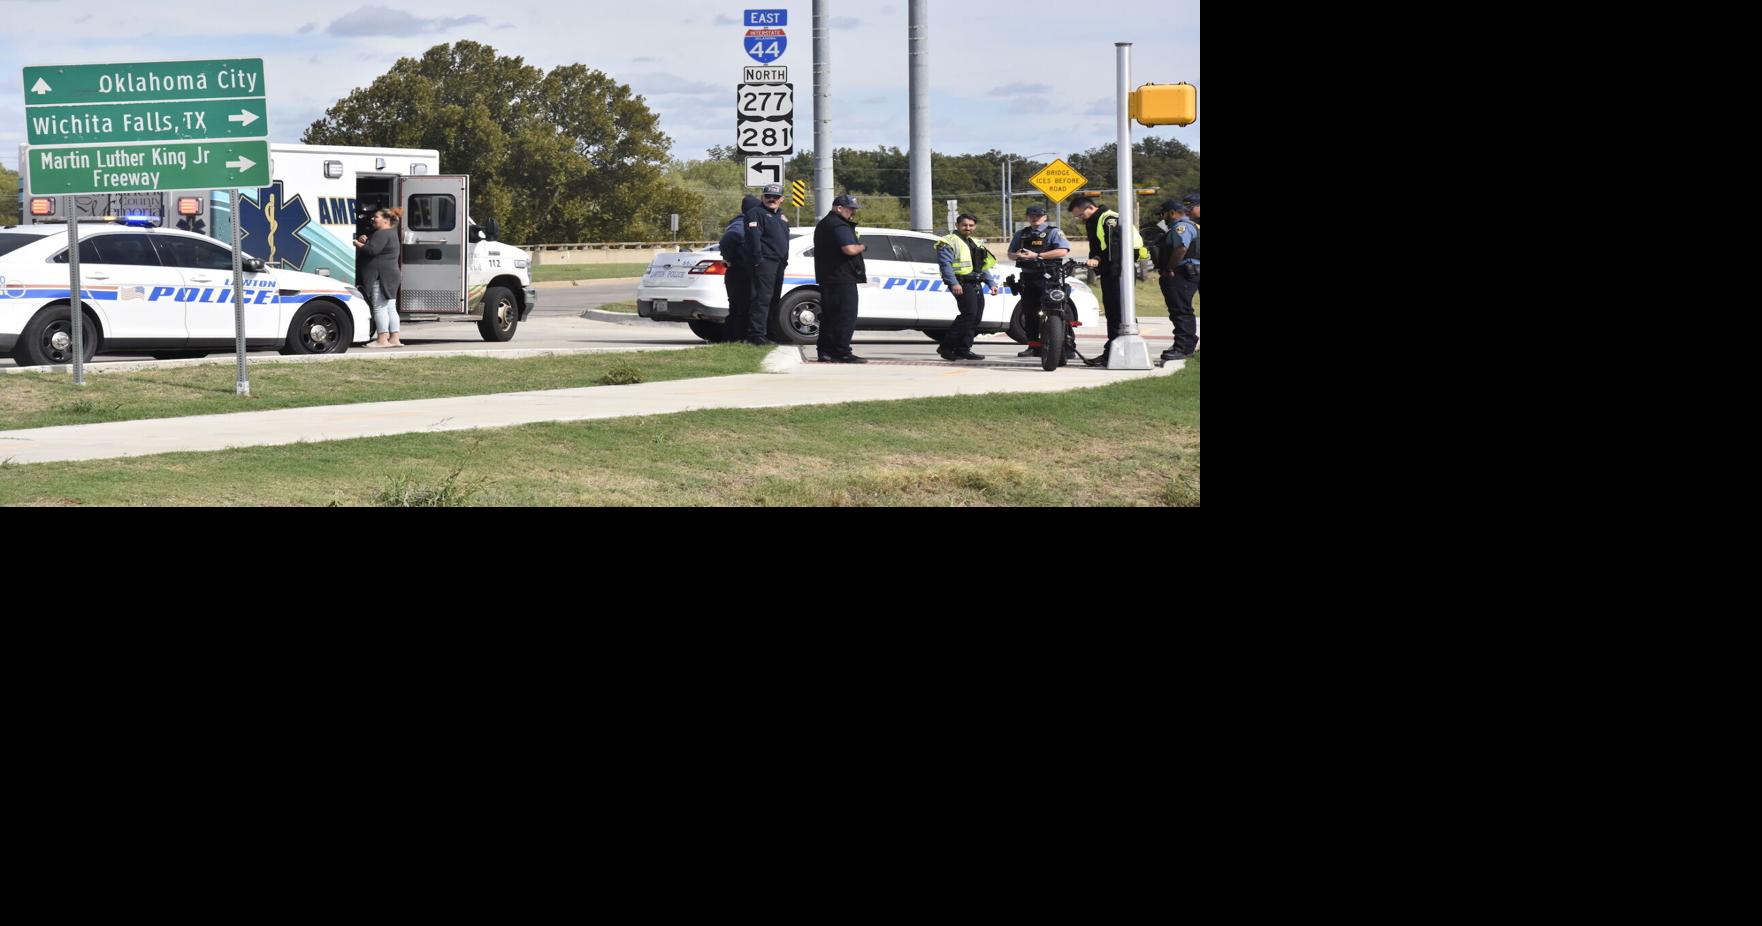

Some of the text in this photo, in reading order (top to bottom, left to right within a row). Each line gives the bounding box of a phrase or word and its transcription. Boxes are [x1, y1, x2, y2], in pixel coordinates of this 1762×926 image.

[750, 12, 781, 24] EAST
[749, 41, 780, 58] 44
[100, 69, 257, 93] Oklahoma City
[746, 69, 785, 81] NORTH
[743, 92, 787, 111] 277
[32, 113, 113, 136] Wichita
[183, 111, 206, 130] TX
[742, 127, 788, 147] 281
[41, 146, 211, 170] Martin Luther King Jr
[93, 169, 160, 189] Freeway
[488, 259, 502, 268] 112
